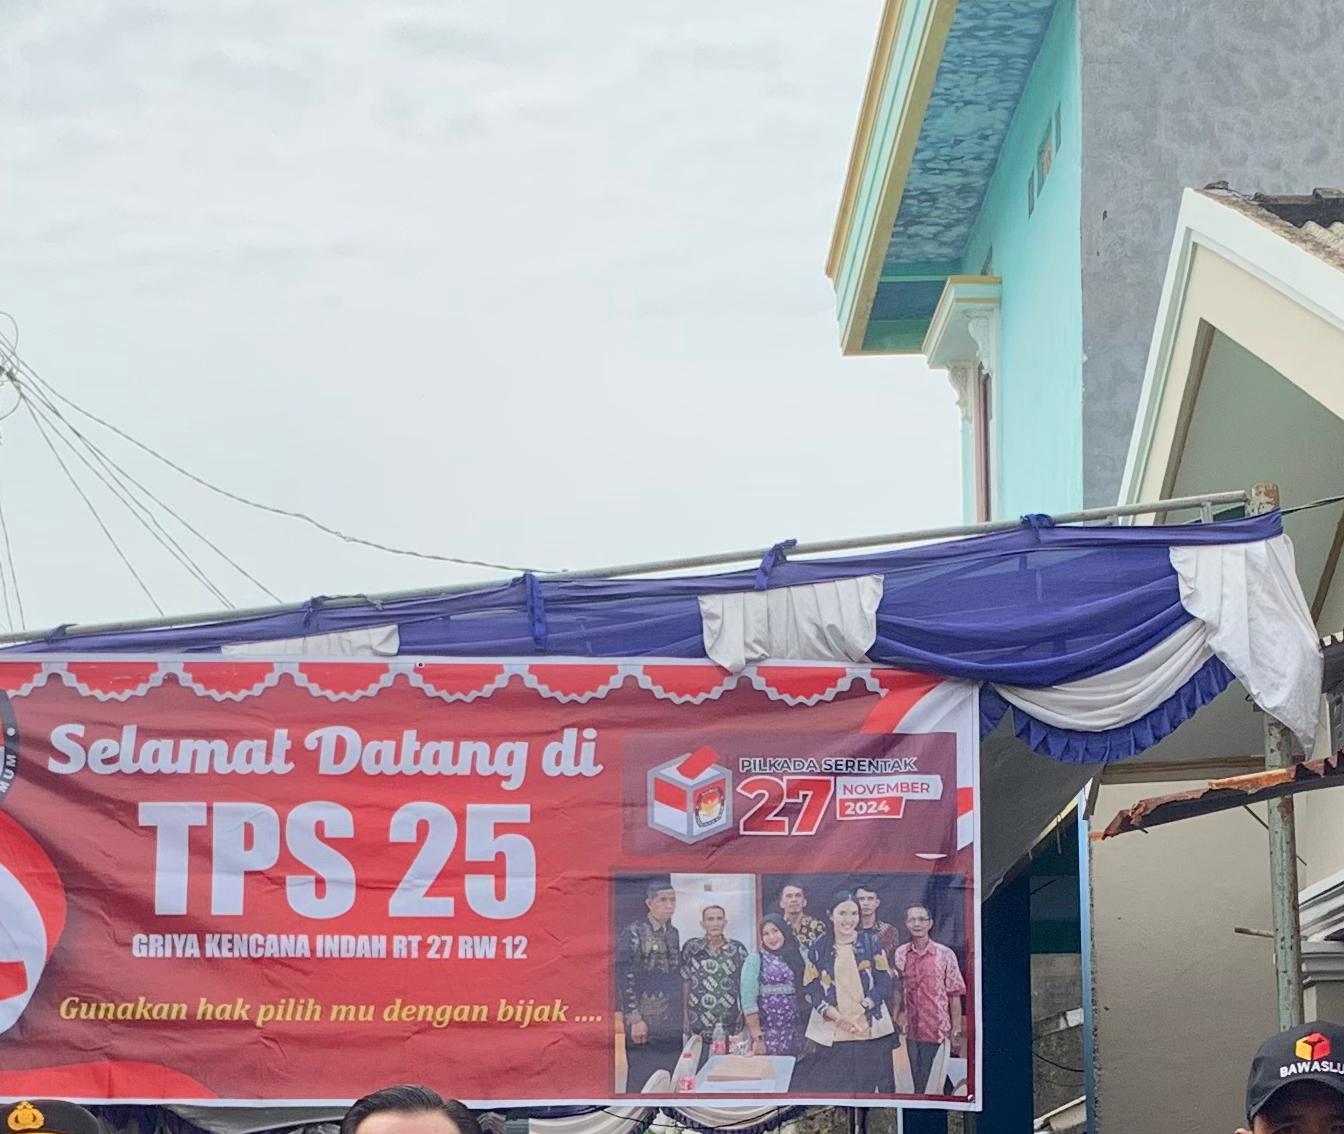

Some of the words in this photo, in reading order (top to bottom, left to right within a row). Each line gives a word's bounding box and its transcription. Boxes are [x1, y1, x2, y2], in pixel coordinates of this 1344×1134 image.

[48, 723, 295, 775] Selamat
[304, 725, 529, 791] Datang
[542, 728, 604, 777] di
[739, 757, 821, 773] PILKADA
[822, 756, 918, 774] SERENTAK
[842, 782, 931, 796] NOVEMBER
[736, 775, 836, 836] 27
[843, 800, 891, 815] 2024
[138, 801, 356, 920] TPS
[388, 801, 537, 920] 25
[132, 933, 202, 959] GRIYA
[206, 933, 312, 959] KENCANA
[316, 934, 387, 959] INDAH
[392, 935, 423, 959] RT
[426, 935, 454, 960] 27
[457, 935, 498, 960] RW
[501, 935, 529, 960] 12
[58, 996, 188, 1021] Gunakan
[195, 997, 253, 1021] hak
[256, 998, 323, 1029] pilih
[329, 1004, 376, 1022] mu
[382, 998, 490, 1029] dengan
[496, 998, 570, 1029] bijak
